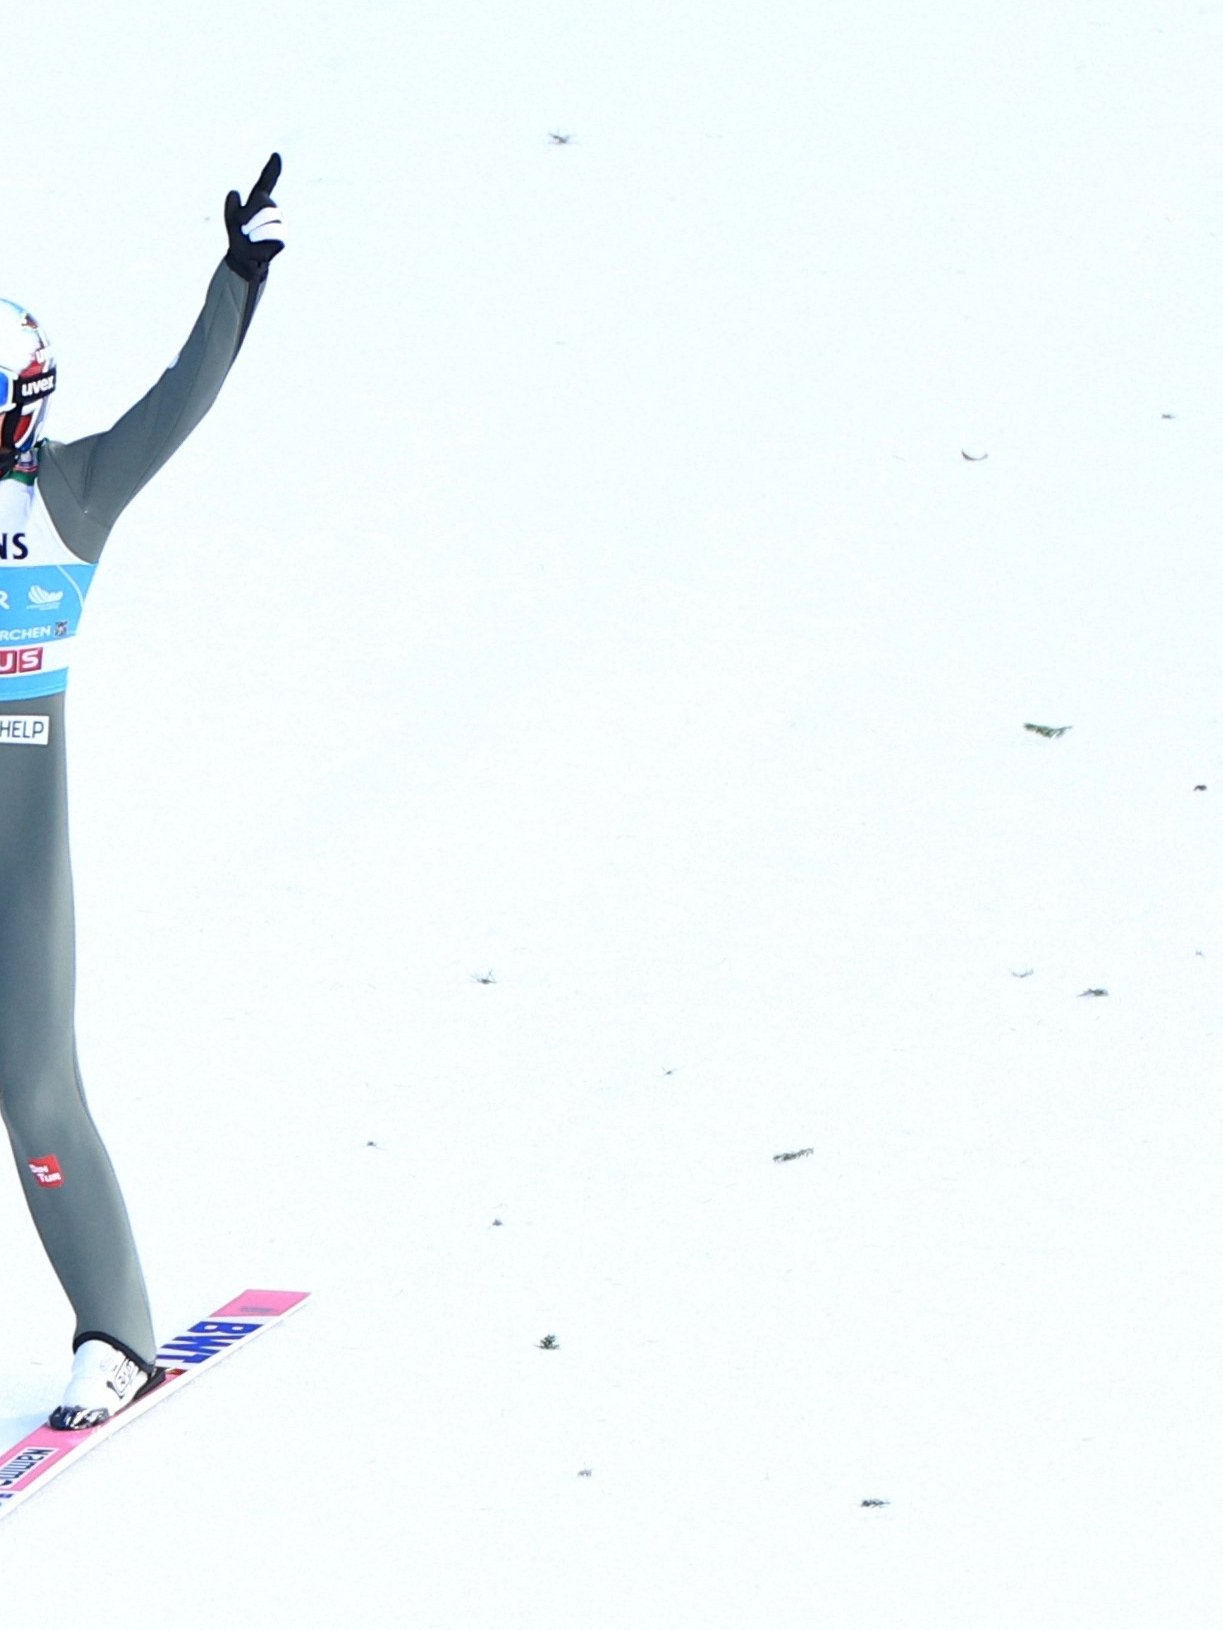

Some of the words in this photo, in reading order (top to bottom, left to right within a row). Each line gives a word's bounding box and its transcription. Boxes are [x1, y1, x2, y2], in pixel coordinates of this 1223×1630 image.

[21, 375, 55, 398] uvex
[0, 720, 44, 739] HELP
[155, 1321, 264, 1364] BWT
